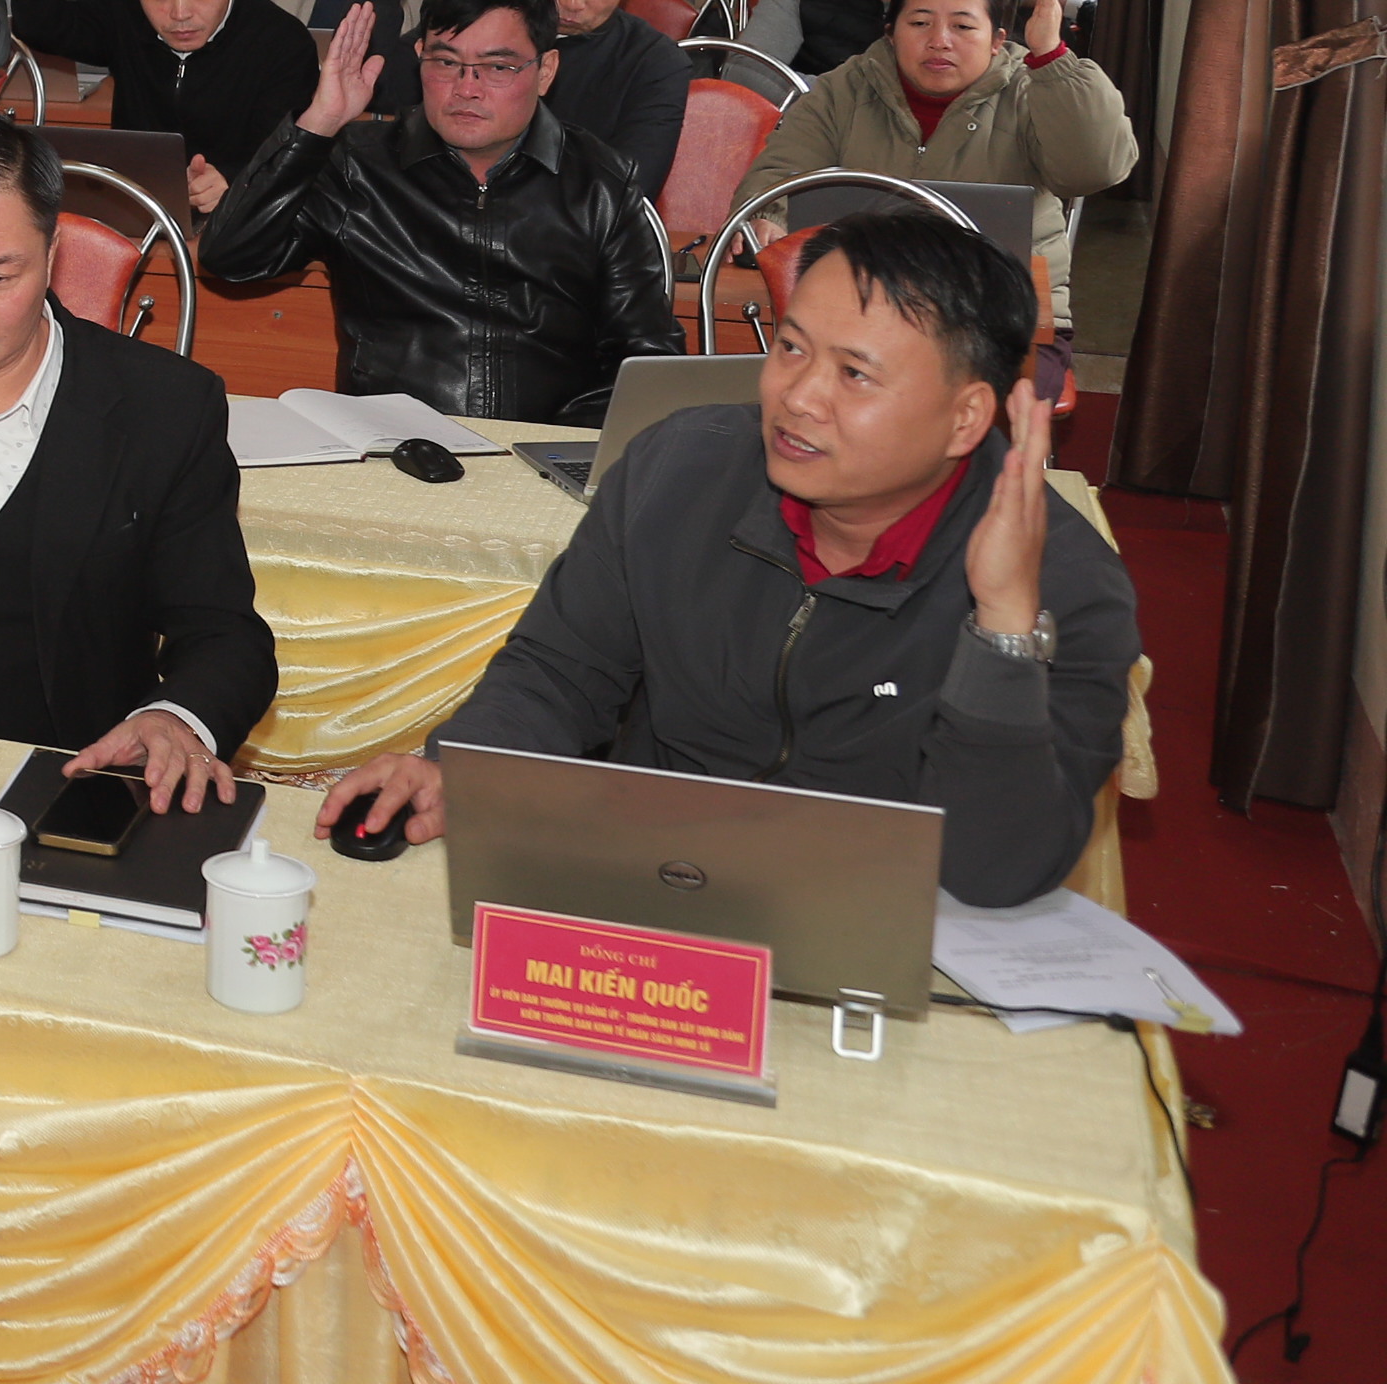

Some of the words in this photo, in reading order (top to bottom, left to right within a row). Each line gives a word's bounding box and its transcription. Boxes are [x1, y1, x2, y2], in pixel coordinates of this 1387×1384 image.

[580, 944, 625, 964] ĐỒNG
[628, 952, 658, 969] CHÍ
[526, 958, 573, 990] MAI
[579, 967, 637, 1001] KIẾN
[642, 978, 710, 1014] QUỐC
